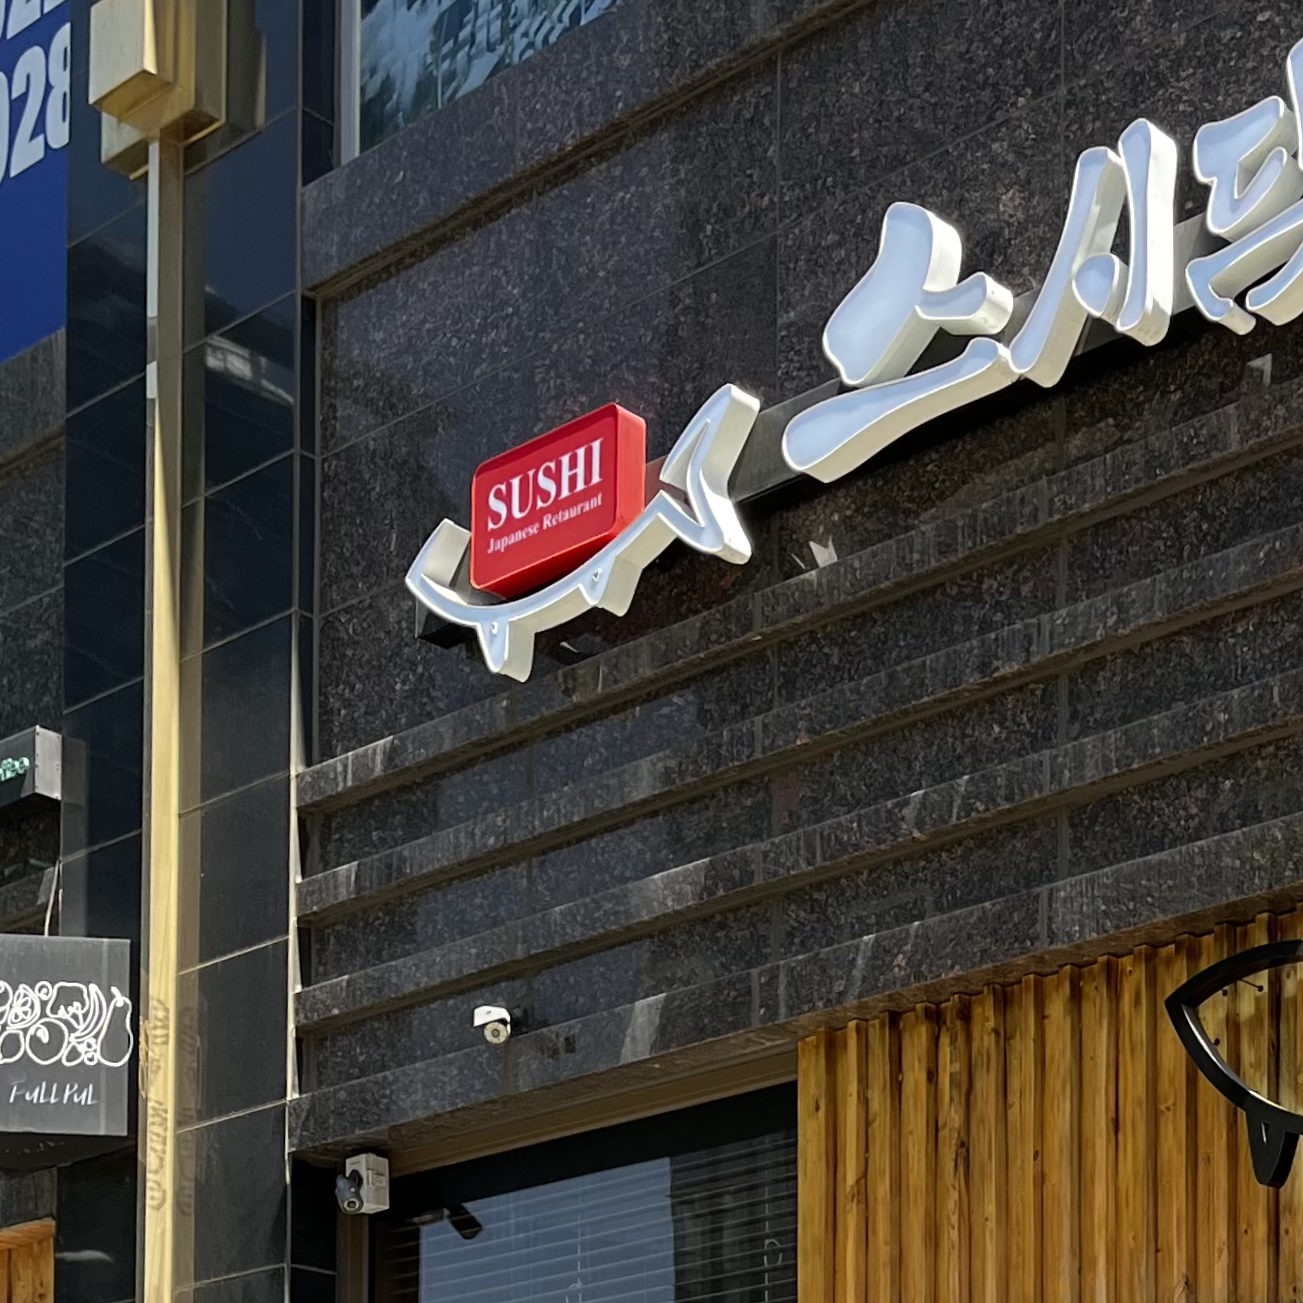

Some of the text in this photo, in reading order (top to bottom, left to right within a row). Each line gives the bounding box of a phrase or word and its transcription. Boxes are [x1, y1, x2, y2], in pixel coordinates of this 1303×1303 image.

[487, 437, 604, 532] SUSHI
[487, 492, 603, 554] Japanese Retaurant
